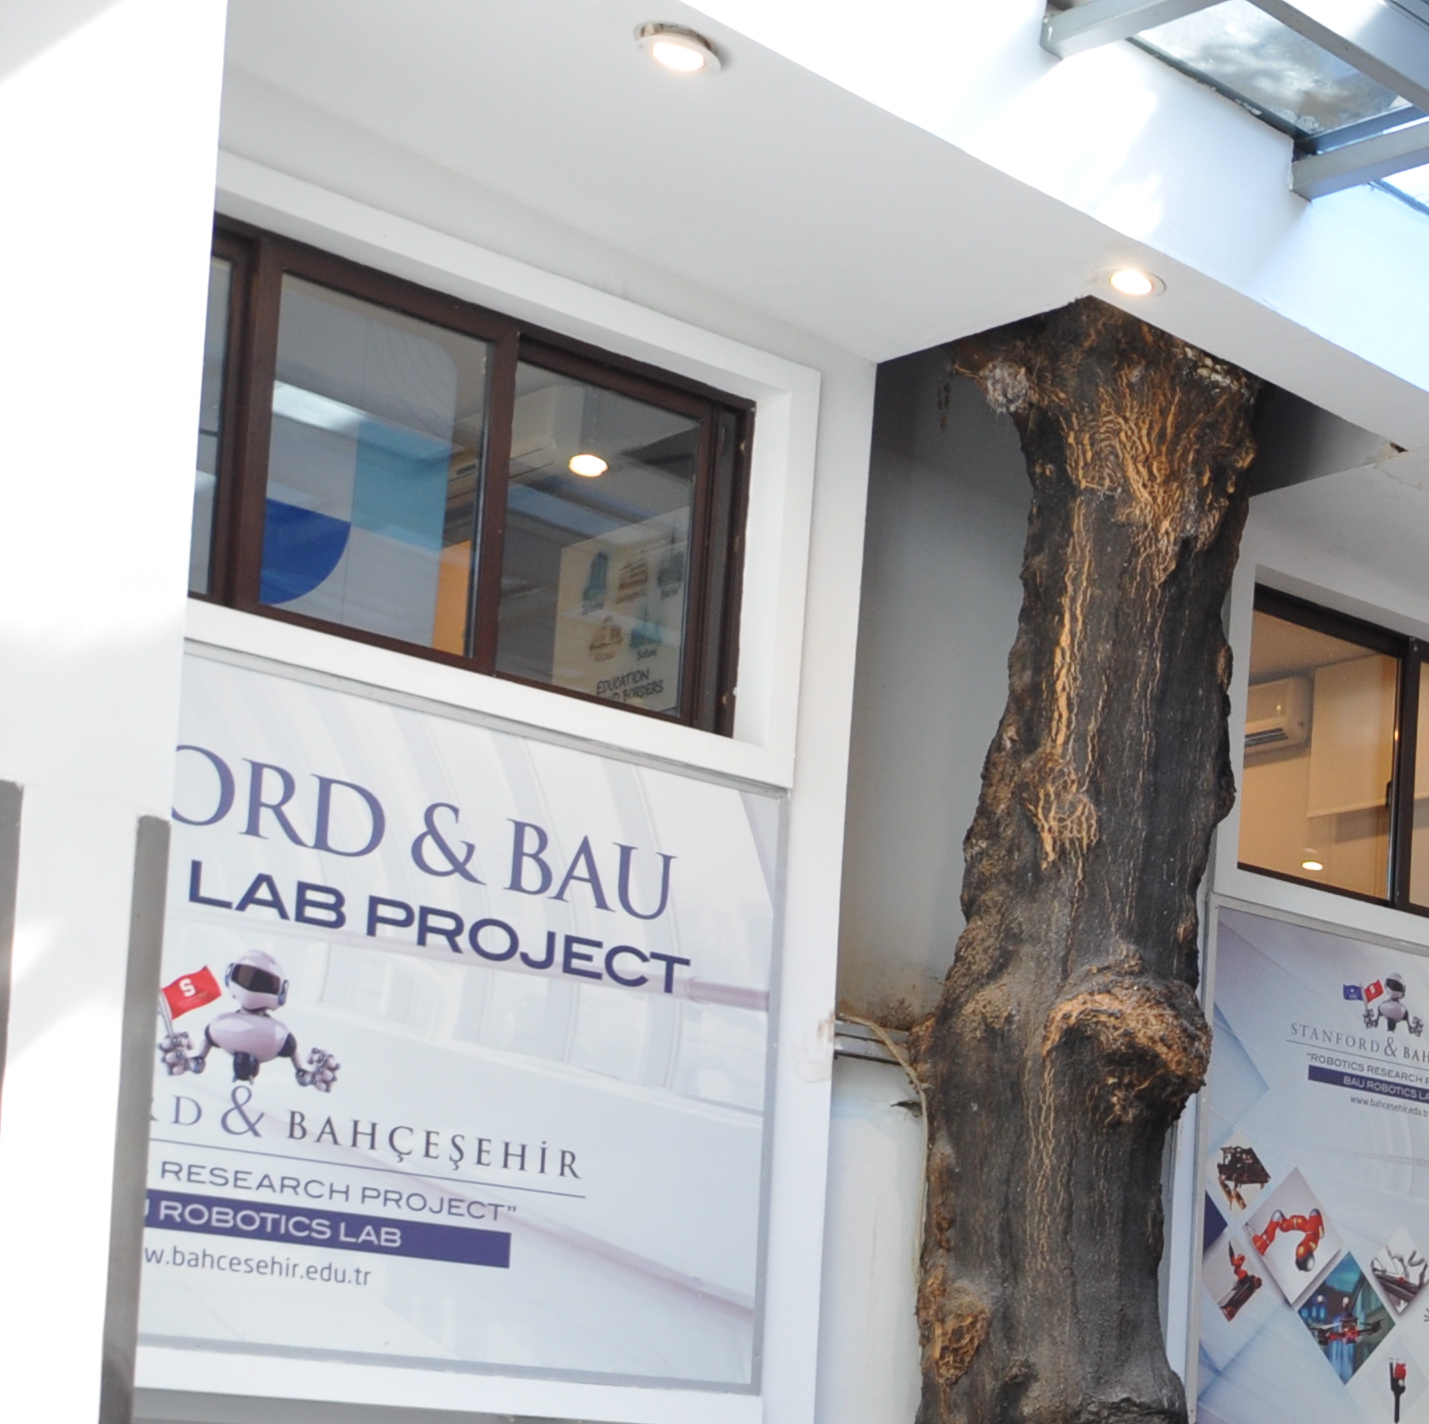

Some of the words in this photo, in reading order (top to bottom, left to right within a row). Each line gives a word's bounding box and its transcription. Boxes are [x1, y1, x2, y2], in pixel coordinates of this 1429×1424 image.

[596, 667, 650, 695] EDUCATION
[171, 744, 386, 858] ORD
[410, 801, 488, 886] &
[502, 817, 679, 921] BAU
[188, 858, 347, 930] LAB
[366, 894, 692, 995] PROJECT
[1290, 1022, 1381, 1054] STANFORD
[1383, 1036, 1398, 1058] &
[1343, 1075, 1366, 1091] BAU
[1366, 1080, 1418, 1100] ROBOTICS
[1366, 1065, 1423, 1085] RESEARCH
[1350, 1095, 1429, 1118] www.bahcesehir.edu.tr
[149, 1094, 203, 1127] D
[220, 1084, 265, 1138] &
[286, 1109, 582, 1180] BAHÇEŞEHİR
[160, 1160, 351, 1203] RESEARCH
[158, 1199, 333, 1240] ROBOTICS
[338, 1221, 402, 1248] LAB
